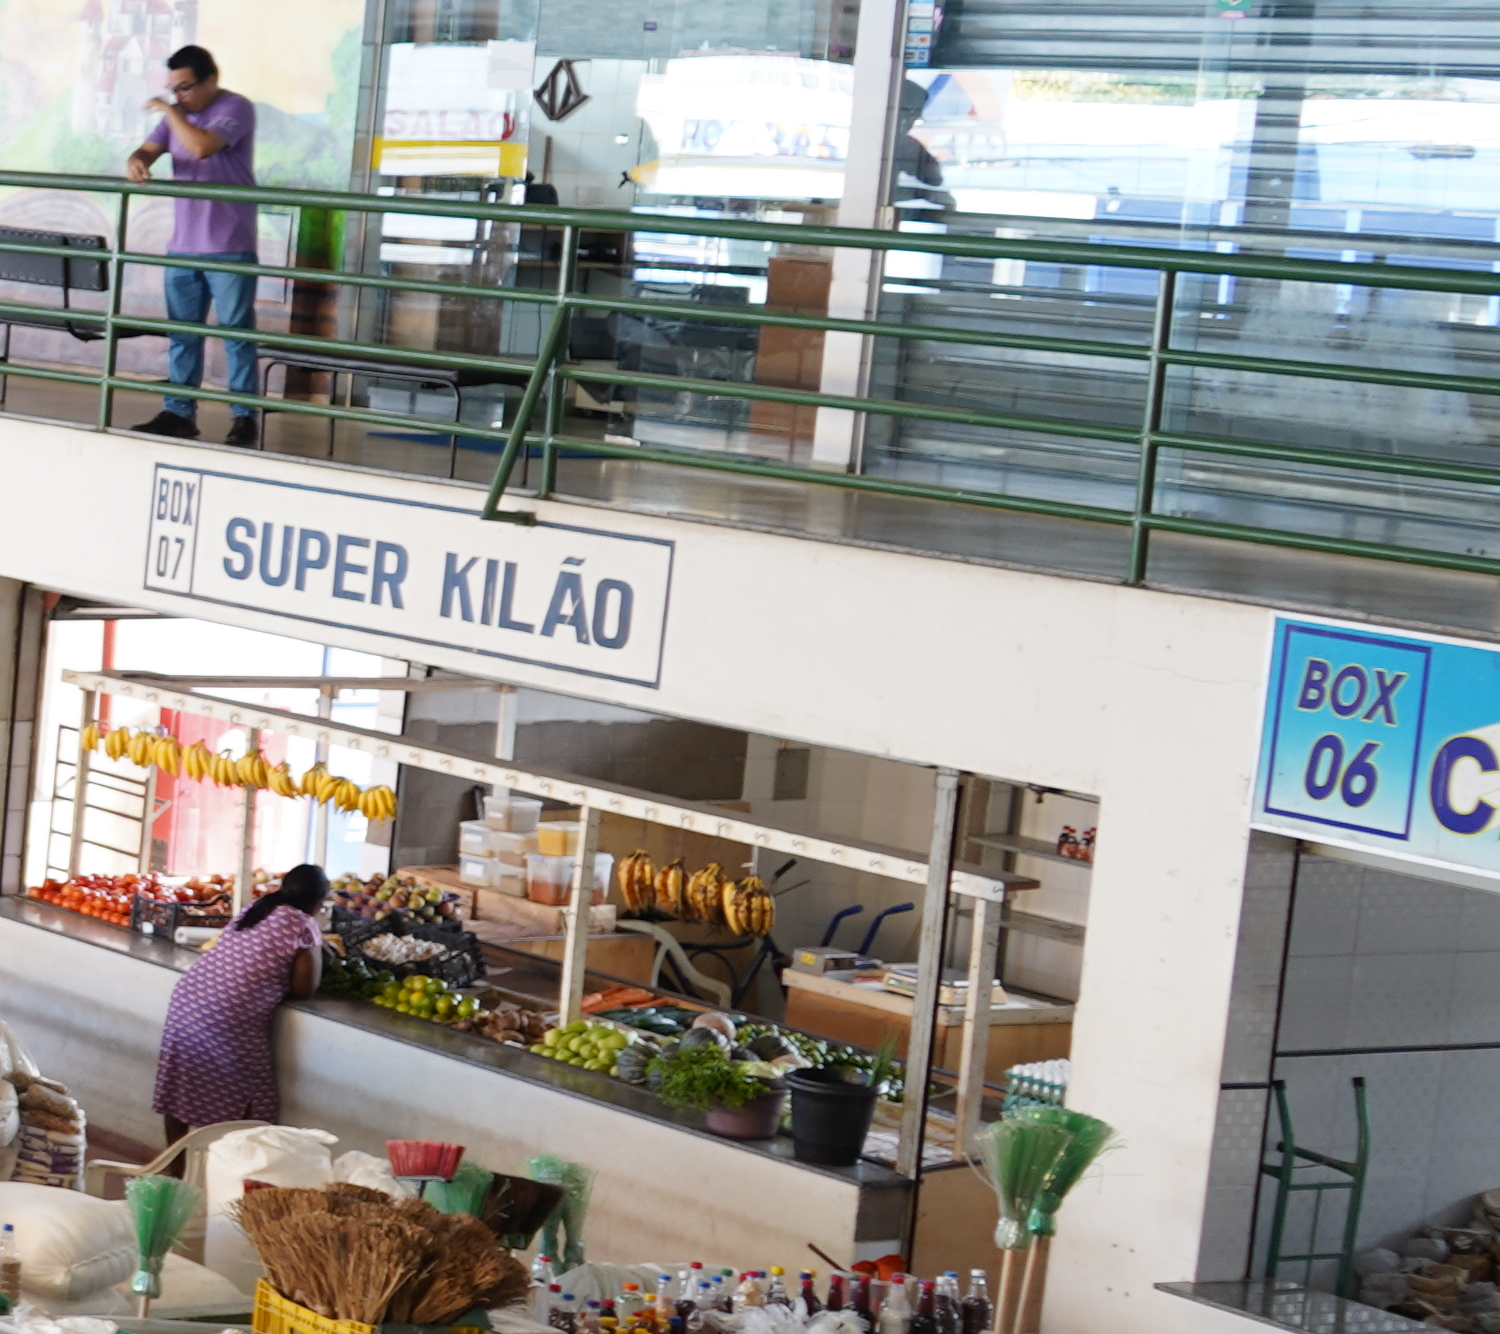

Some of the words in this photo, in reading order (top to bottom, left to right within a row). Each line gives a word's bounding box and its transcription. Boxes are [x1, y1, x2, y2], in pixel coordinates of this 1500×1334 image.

[157, 478, 195, 528] BOX
[156, 534, 185, 581] 07
[222, 515, 409, 612] SUPER
[440, 553, 634, 649] KILÃO
[1297, 657, 1407, 727] BOX
[1303, 732, 1379, 810] 06
